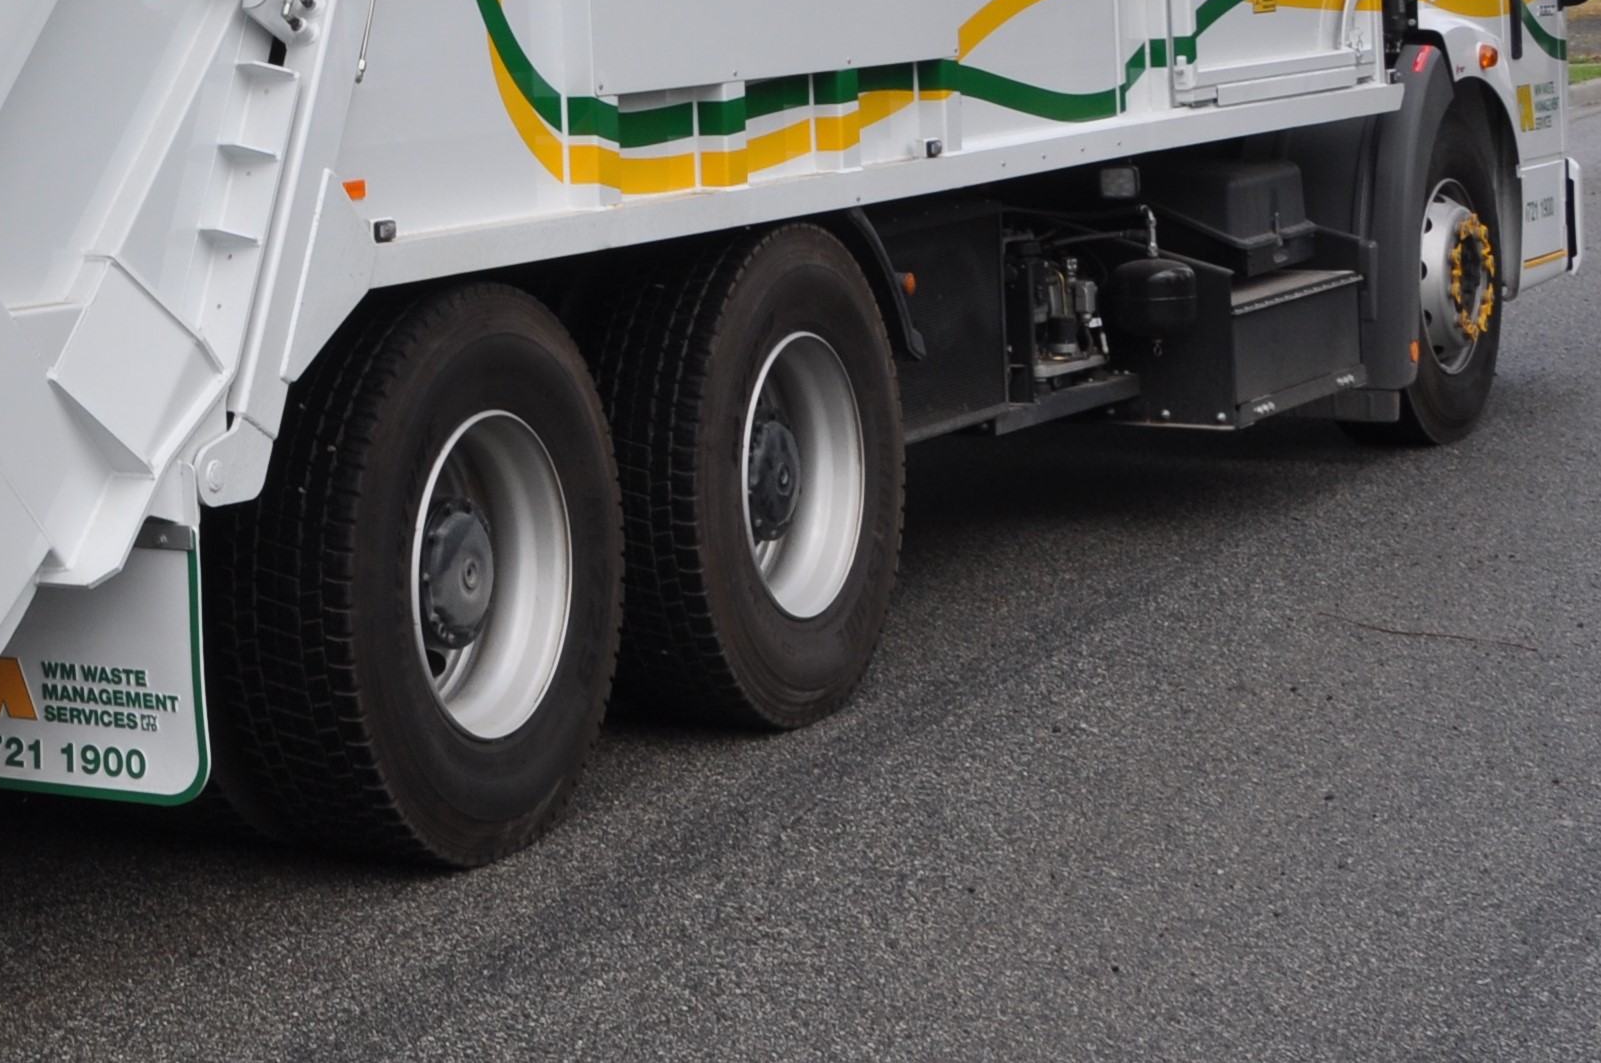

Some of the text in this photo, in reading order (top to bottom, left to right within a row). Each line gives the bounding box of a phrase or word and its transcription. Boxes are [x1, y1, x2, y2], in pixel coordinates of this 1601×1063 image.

[41, 661, 147, 687] WM WASTE
[42, 683, 179, 713] MANAGEMENT
[44, 705, 138, 730] SERVICES
[61, 742, 147, 780] 1900
